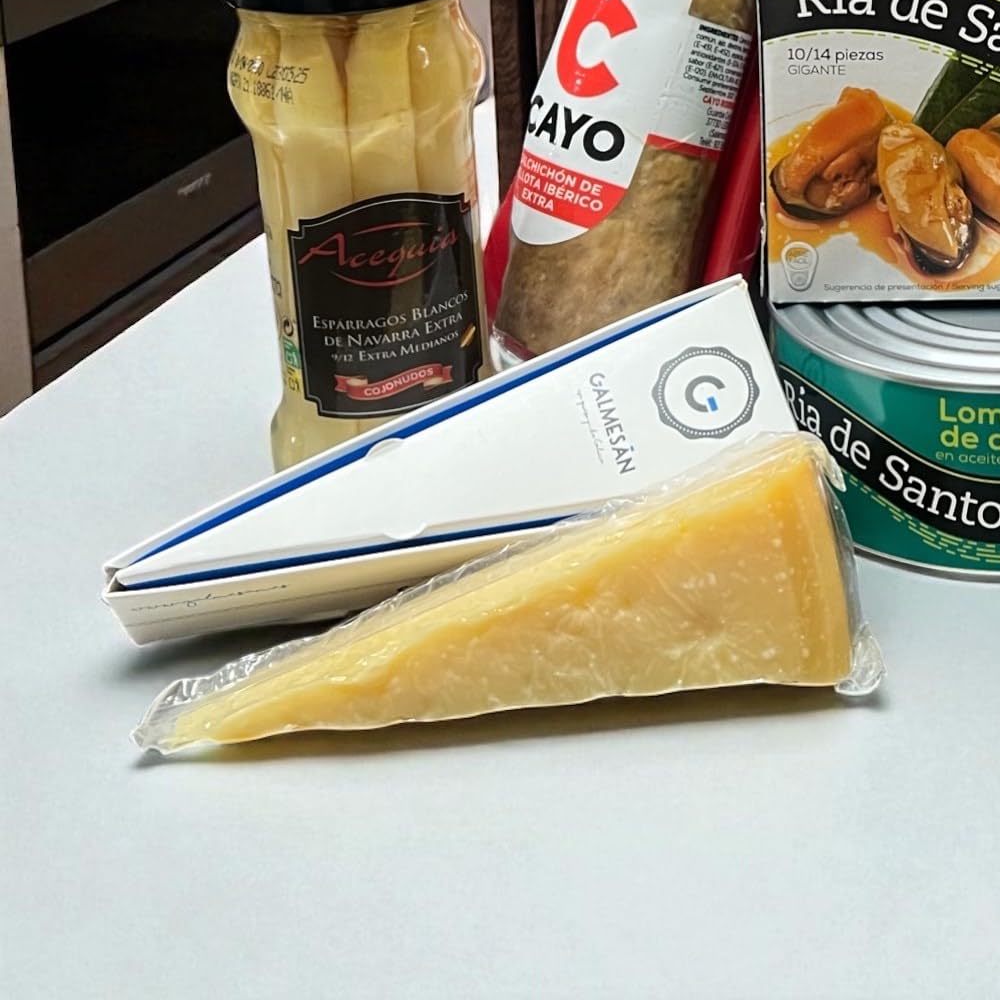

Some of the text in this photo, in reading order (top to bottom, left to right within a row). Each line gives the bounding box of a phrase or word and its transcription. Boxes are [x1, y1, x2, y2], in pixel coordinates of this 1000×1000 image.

[787, 47, 885, 65] 10/14 piezas
[787, 64, 846, 76] GIGANTE
[528, 95, 625, 161] CAYO
[521, 188, 554, 211] EXTRA
[544, 181, 603, 212] IBÉRICO
[580, 179, 603, 196] DE
[298, 227, 458, 278] Acequia
[412, 290, 469, 321] BLANCOS
[324, 312, 463, 348] DE NAVARRA EXTRA
[359, 350, 397, 362] EXTRA
[400, 331, 459, 356] MEDIANOS
[363, 367, 434, 397] COJONUDOS
[589, 373, 636, 474] GALMESÁN
[939, 426, 979, 449] de
[829, 419, 871, 469] de
[935, 451, 955, 462] en
